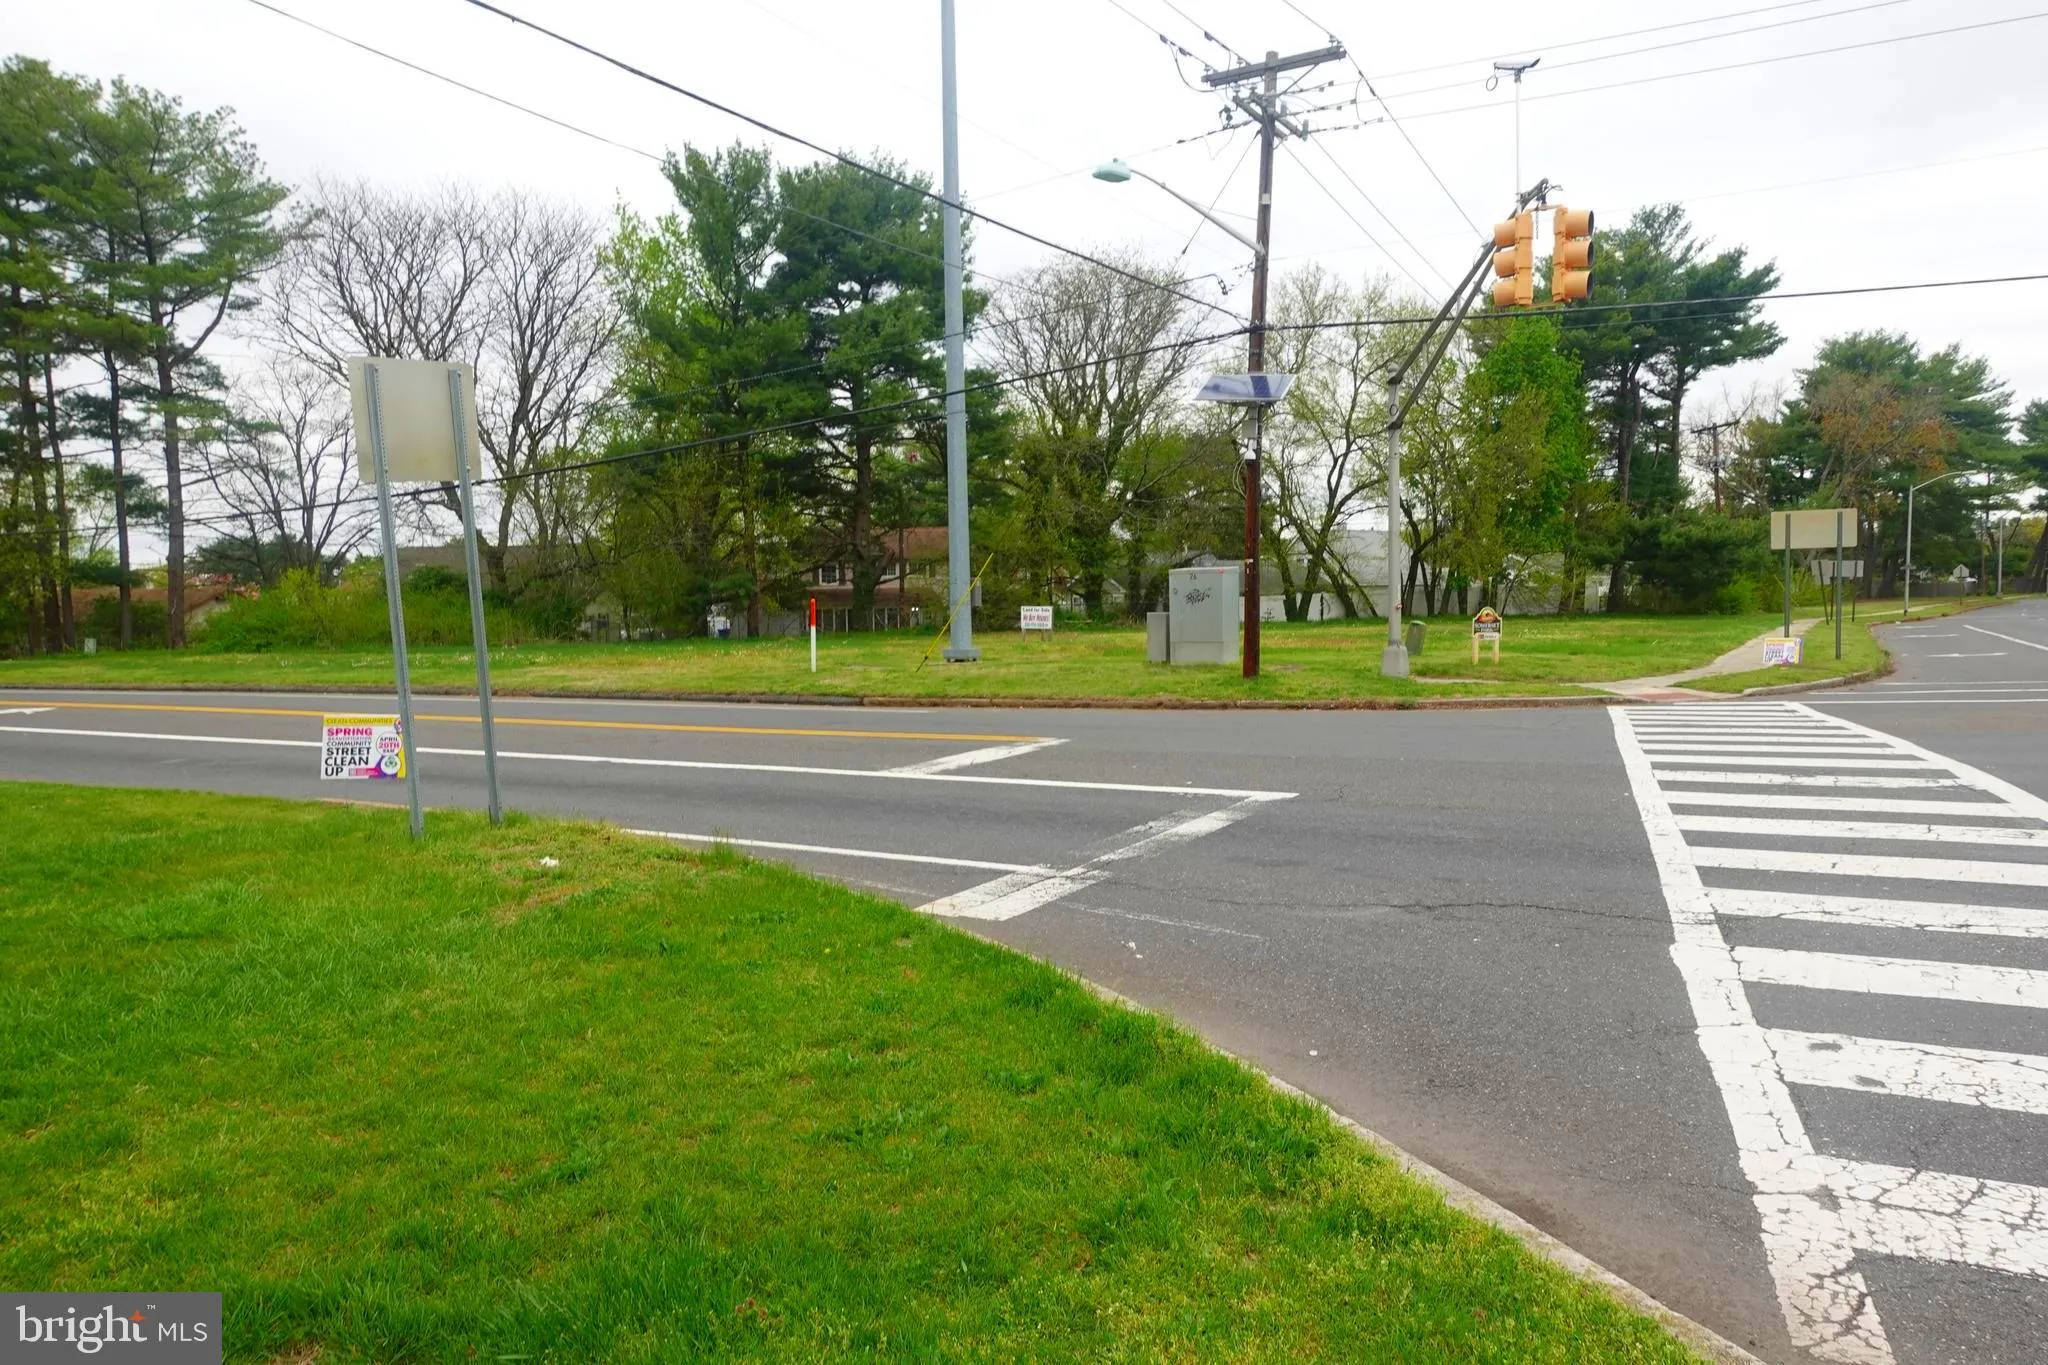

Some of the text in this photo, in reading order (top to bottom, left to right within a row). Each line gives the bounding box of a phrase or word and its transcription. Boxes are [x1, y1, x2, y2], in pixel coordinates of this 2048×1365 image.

[327, 728, 373, 737] SPRING
[379, 741, 400, 749] 20TH
[326, 746, 371, 756] STREET
[325, 756, 369, 767] CLEAN
[325, 767, 344, 777] UP
